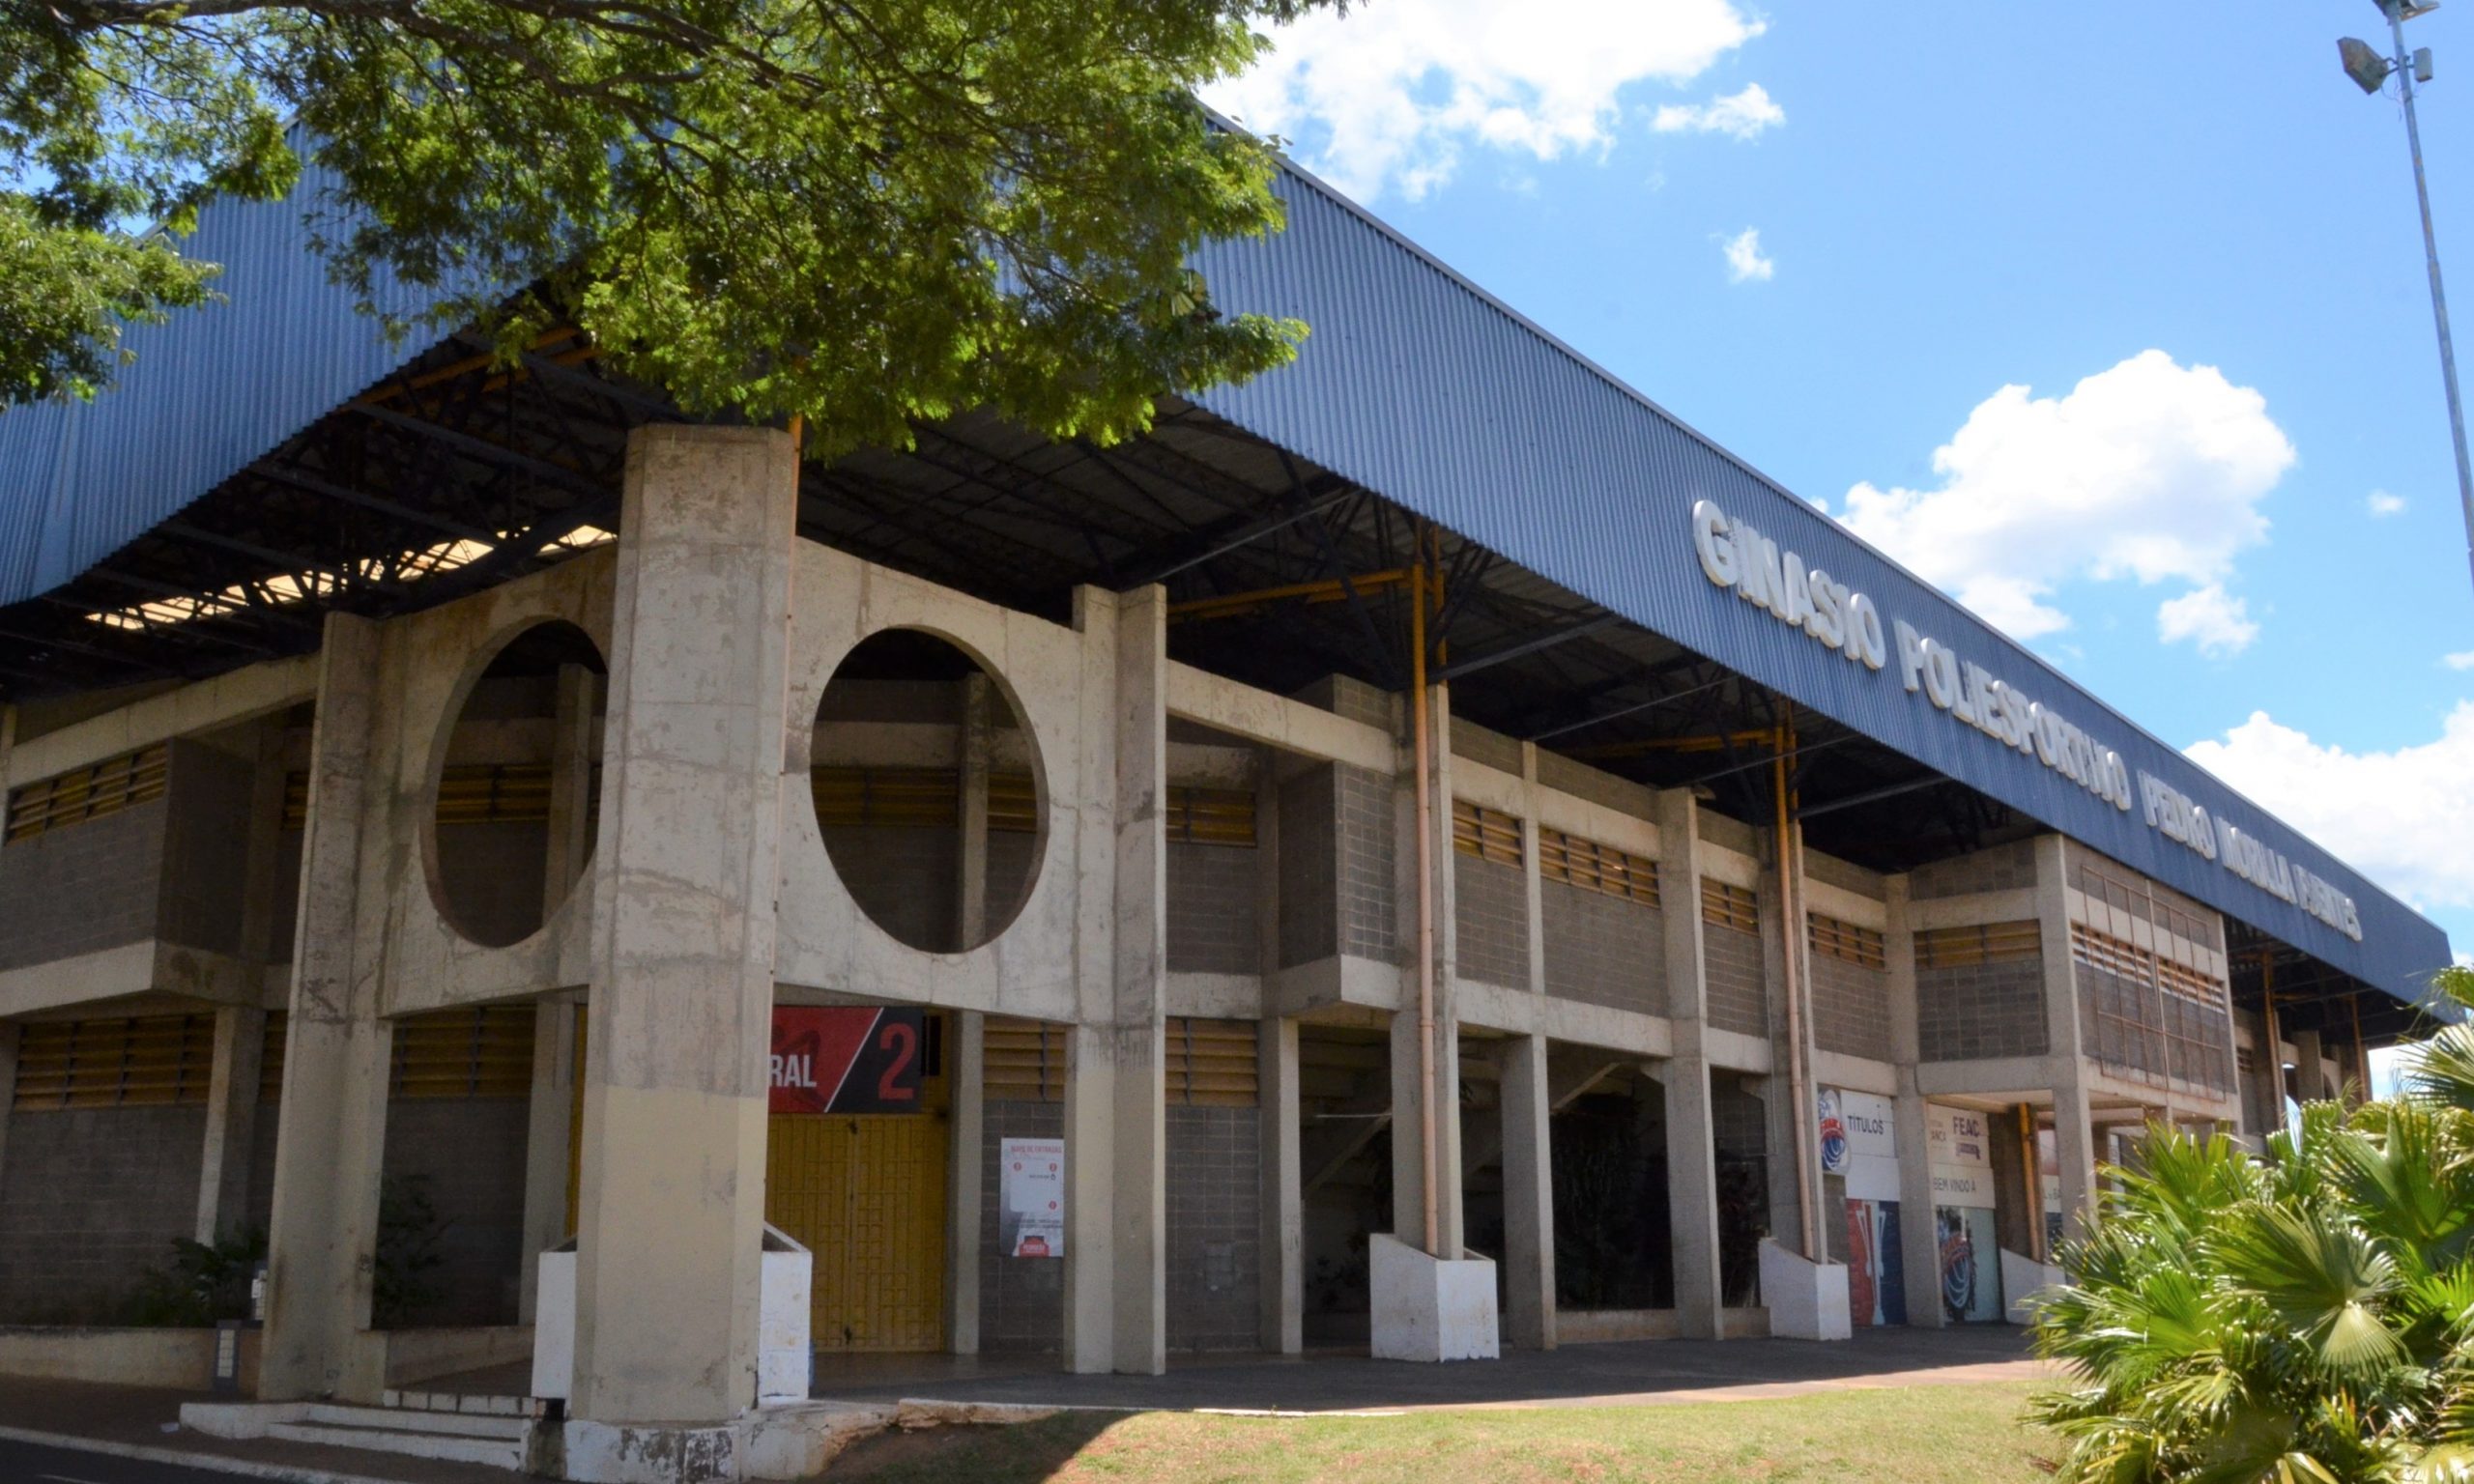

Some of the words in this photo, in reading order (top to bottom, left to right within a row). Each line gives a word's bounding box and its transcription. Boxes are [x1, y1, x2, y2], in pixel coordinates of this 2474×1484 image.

[1893, 617, 2132, 812] POLIESPORTIVO
[2137, 769, 2217, 860] PEDRO
[877, 1022, 917, 1100] 2
[1952, 1115, 1980, 1138] FEAC
